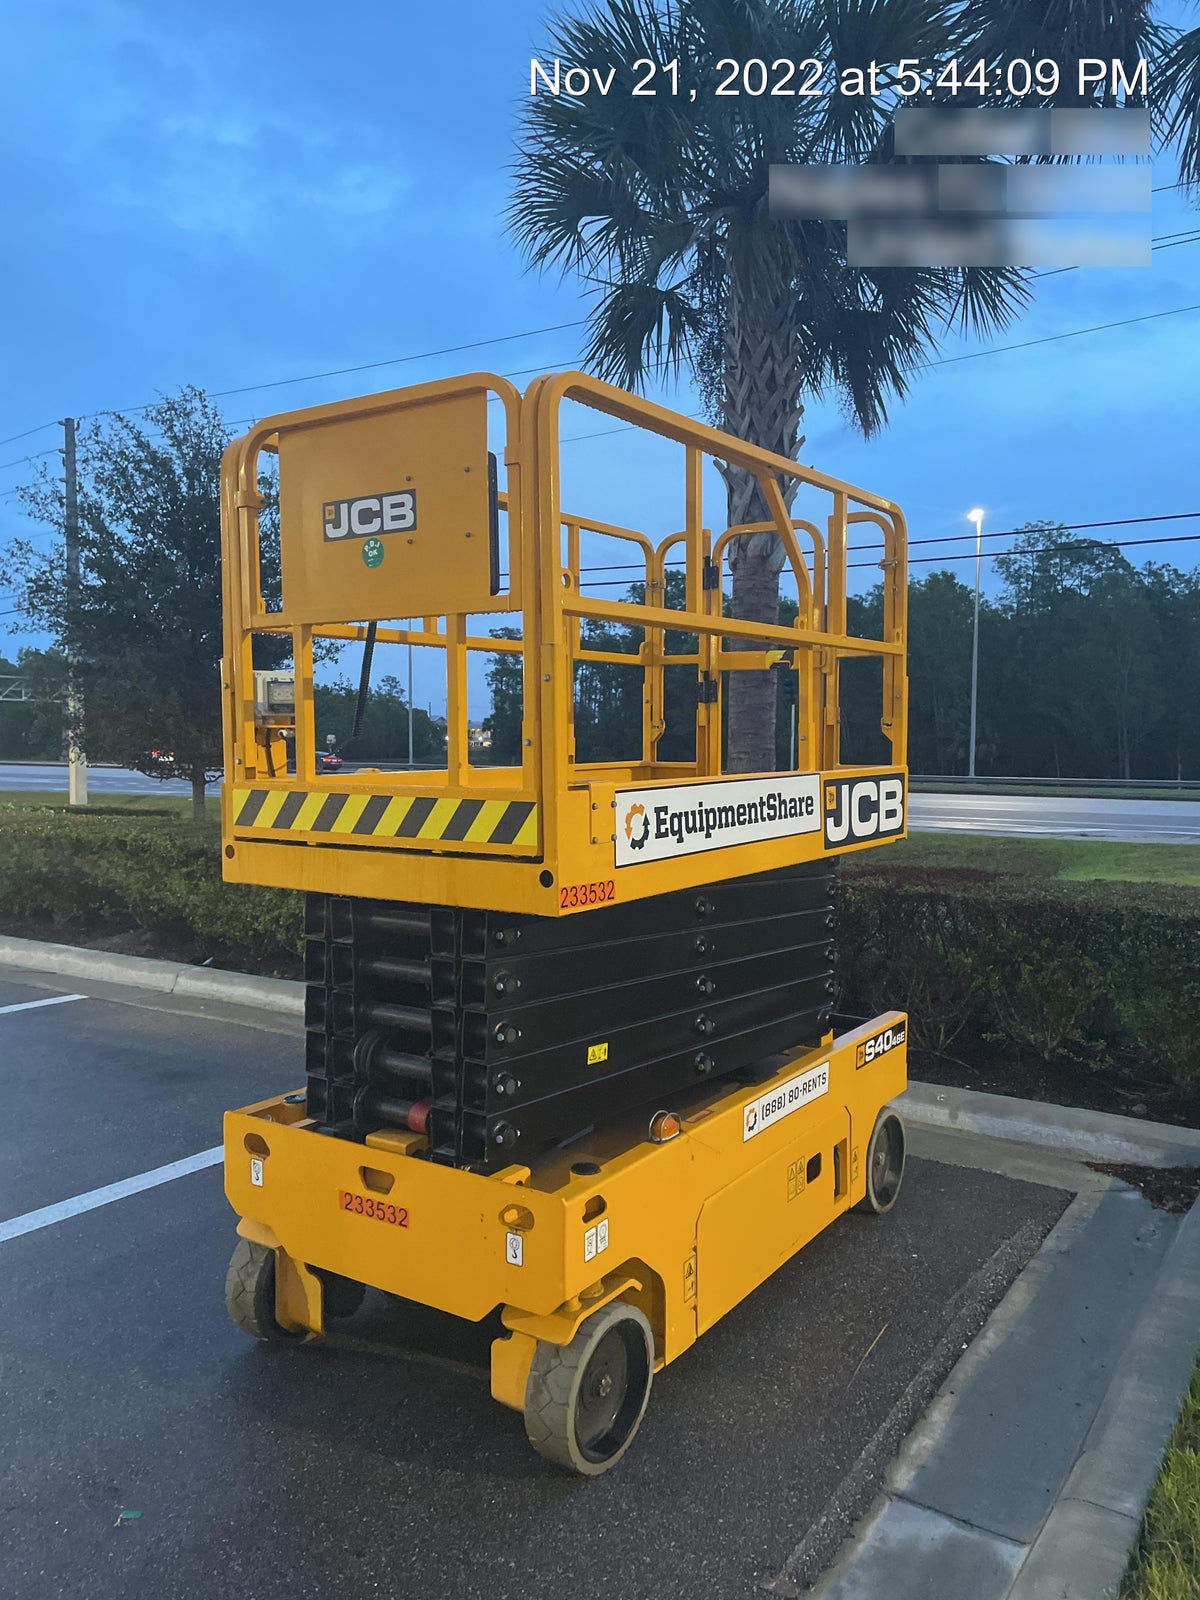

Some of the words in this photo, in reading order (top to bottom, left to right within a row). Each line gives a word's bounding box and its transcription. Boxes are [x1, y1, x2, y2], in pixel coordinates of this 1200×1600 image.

[325, 493, 415, 538] JCB
[654, 793, 815, 843] EquipmentShare
[826, 779, 904, 842] JCB
[560, 880, 615, 909] 233532
[761, 1093, 786, 1121] (888)
[788, 1072, 827, 1104] 80-RENTS
[343, 1192, 409, 1229] 233532
